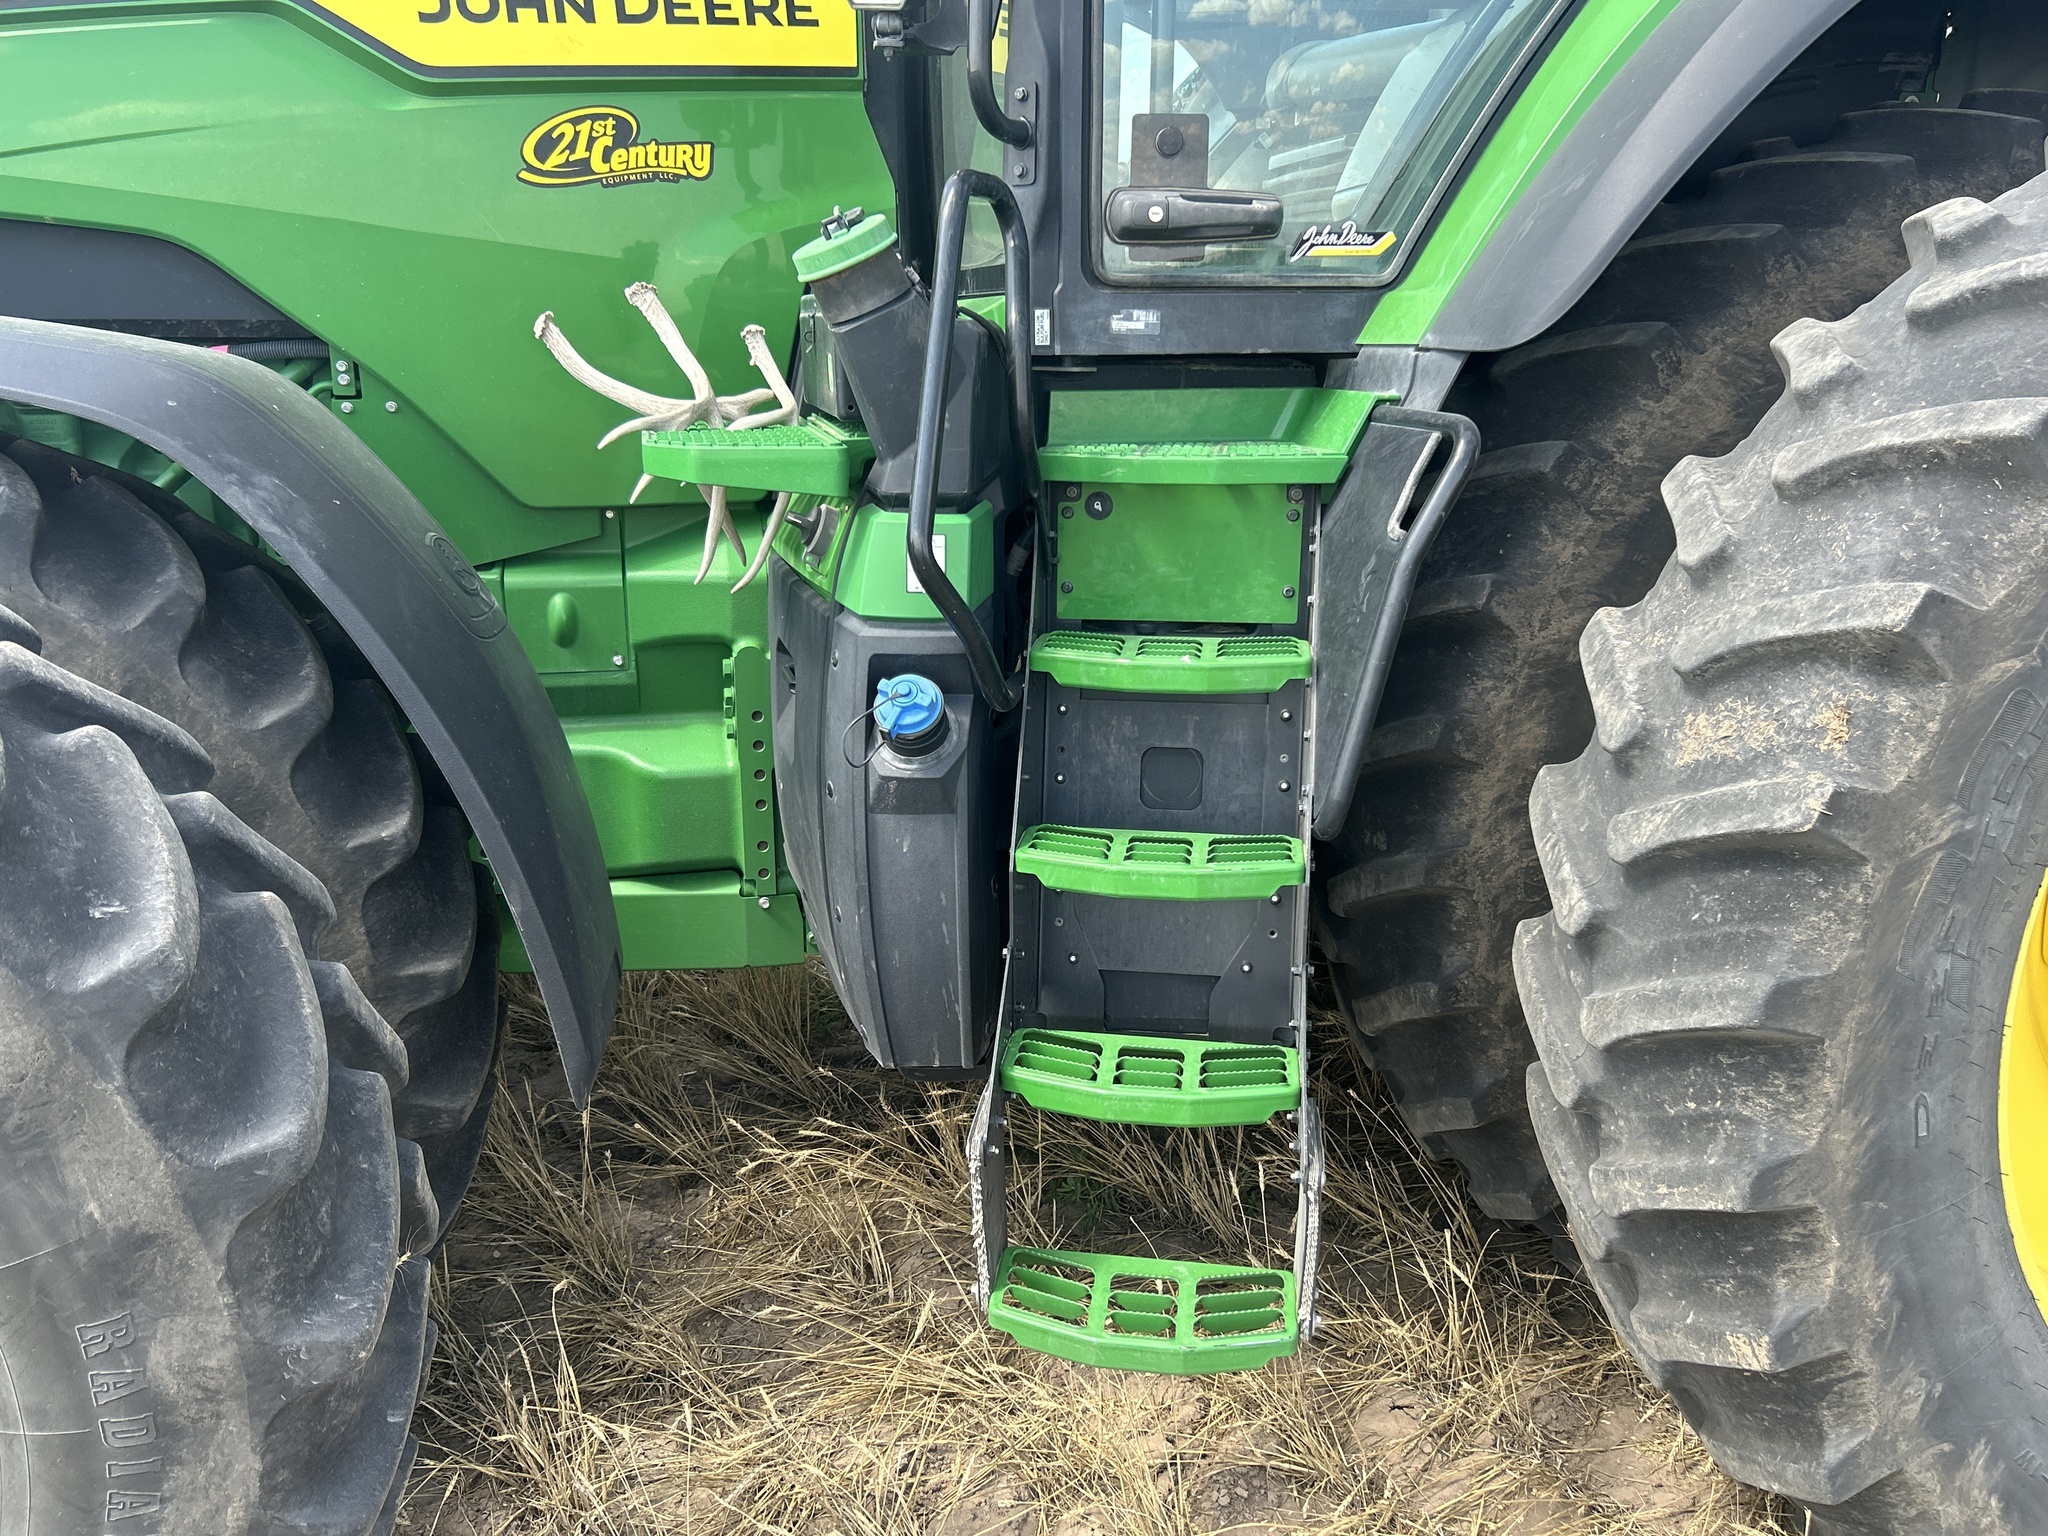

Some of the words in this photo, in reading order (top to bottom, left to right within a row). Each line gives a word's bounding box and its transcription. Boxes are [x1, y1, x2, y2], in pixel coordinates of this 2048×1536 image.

[418, 0, 597, 24] JOHN
[614, 0, 820, 27] DEERE
[543, 116, 617, 171] 21st
[602, 172, 654, 185] EQUIPMENT
[1290, 224, 1340, 263] John
[1337, 220, 1376, 246] Deere
[75, 1310, 162, 1536] RADIA
